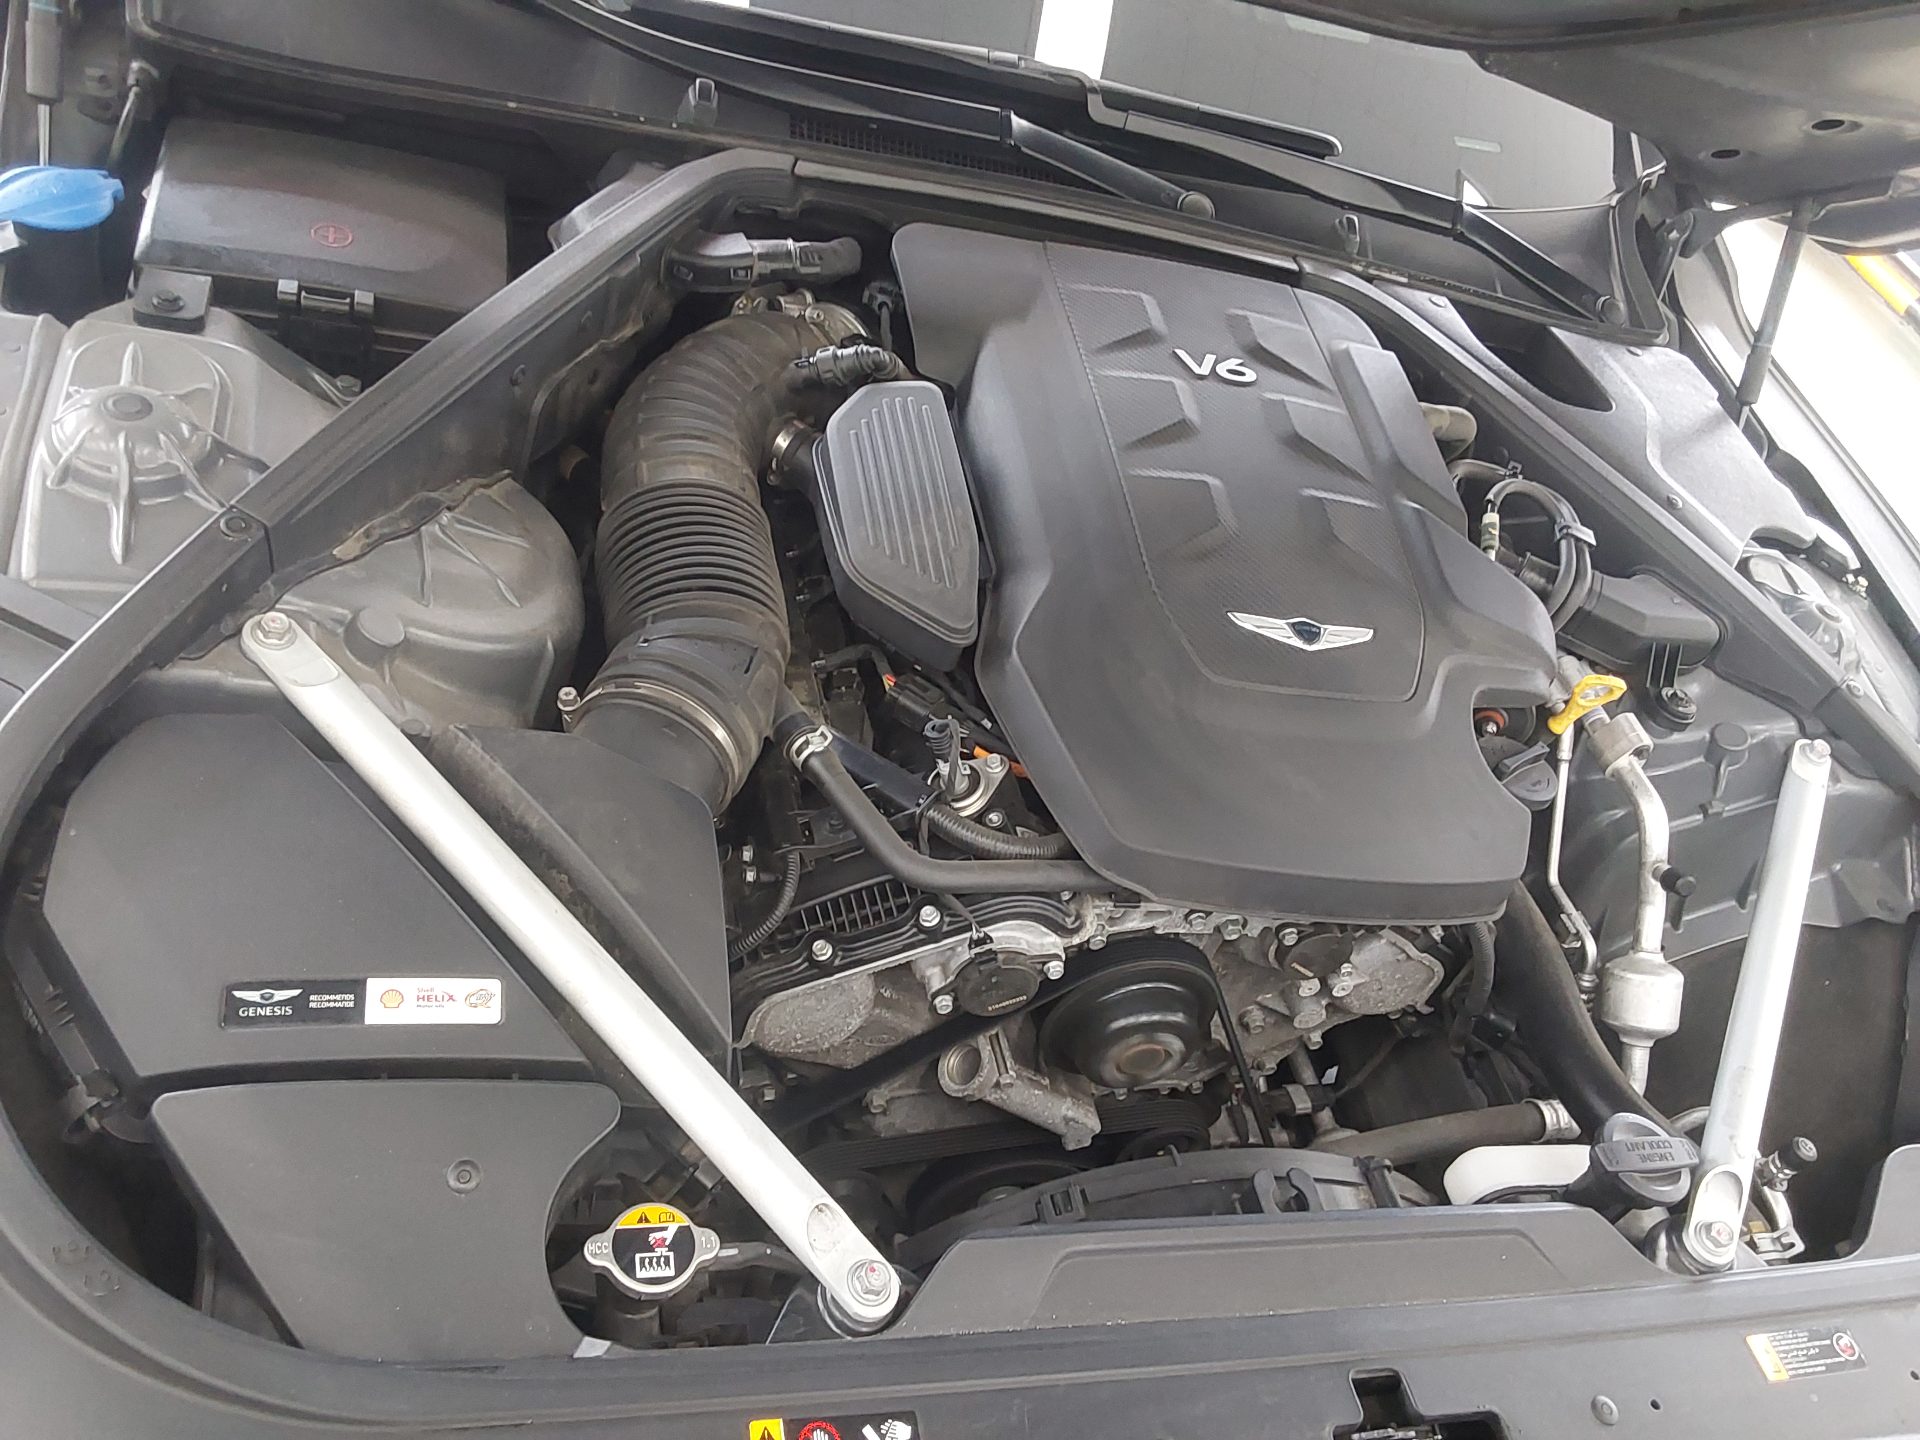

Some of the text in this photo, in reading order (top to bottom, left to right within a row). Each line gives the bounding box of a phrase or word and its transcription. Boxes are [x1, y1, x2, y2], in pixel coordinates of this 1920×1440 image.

[1172, 348, 1257, 383] V6
[309, 993, 355, 1001] RECOMMENDS
[416, 991, 458, 1002] HELIX
[238, 1005, 293, 1017] GENESIS
[1624, 1141, 1673, 1152] COOLANT
[1638, 1152, 1675, 1163] ENGINE
[701, 1236, 716, 1249] 1.1
[587, 1242, 609, 1255] HCC
